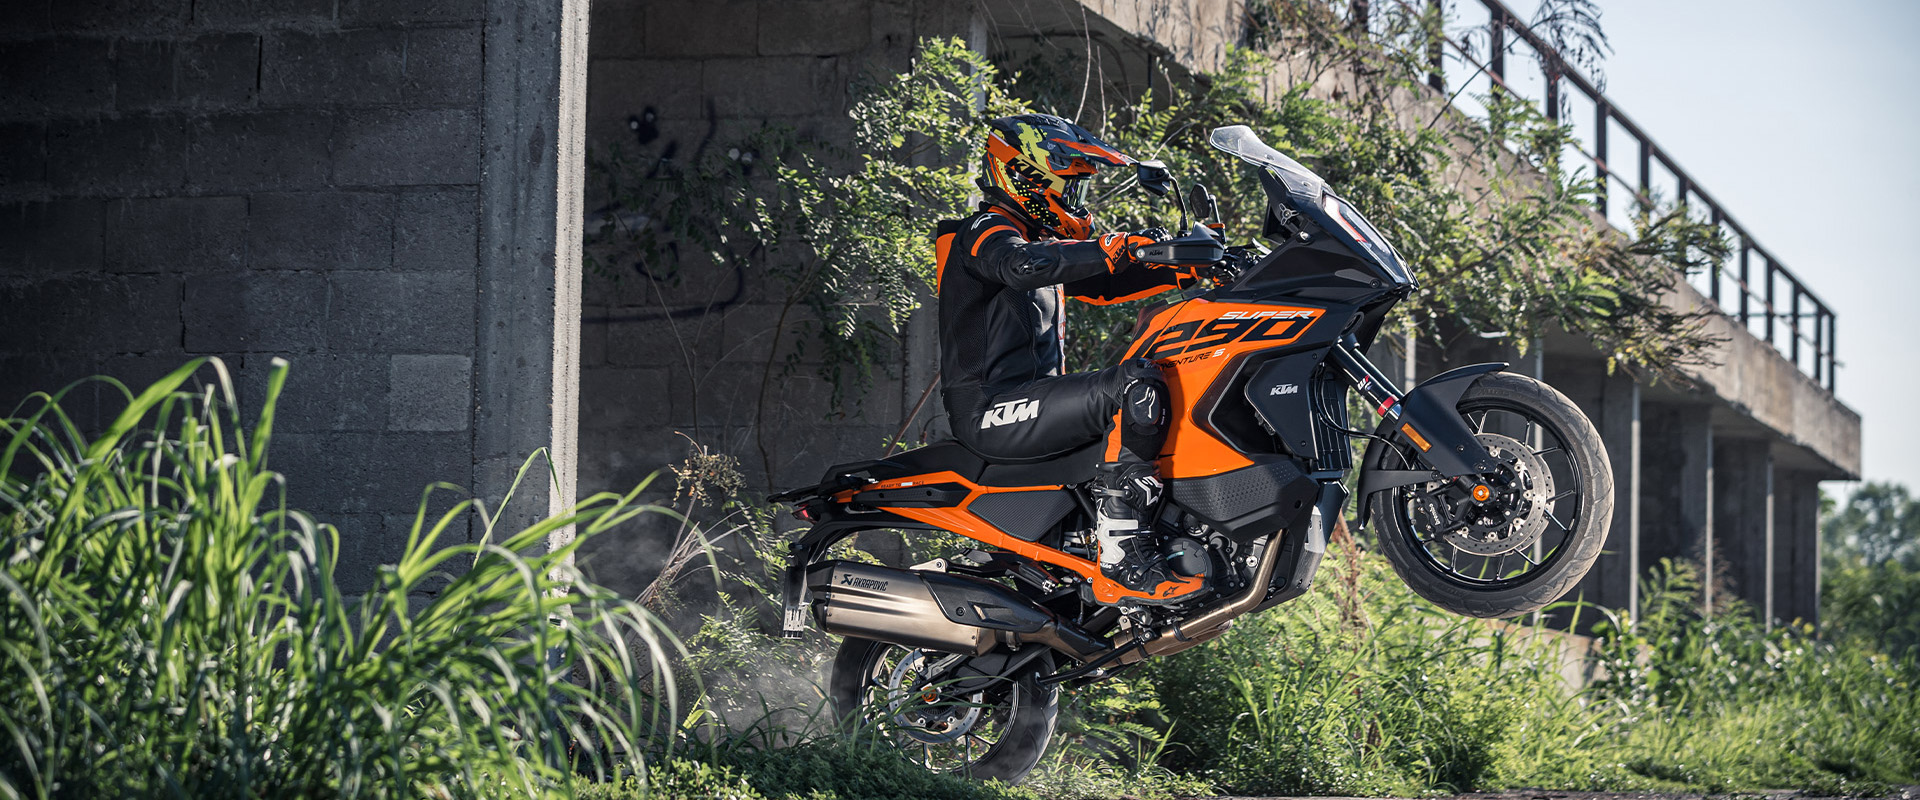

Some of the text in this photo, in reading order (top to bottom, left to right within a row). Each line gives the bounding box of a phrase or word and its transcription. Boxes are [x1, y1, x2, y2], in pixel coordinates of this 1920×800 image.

[1006, 157, 1054, 190] KTM
[1112, 244, 1126, 262] KTM
[1218, 310, 1315, 320] SUPER
[1212, 348, 1226, 358] S
[1270, 383, 1298, 396] KTM
[981, 398, 1040, 429] KTM
